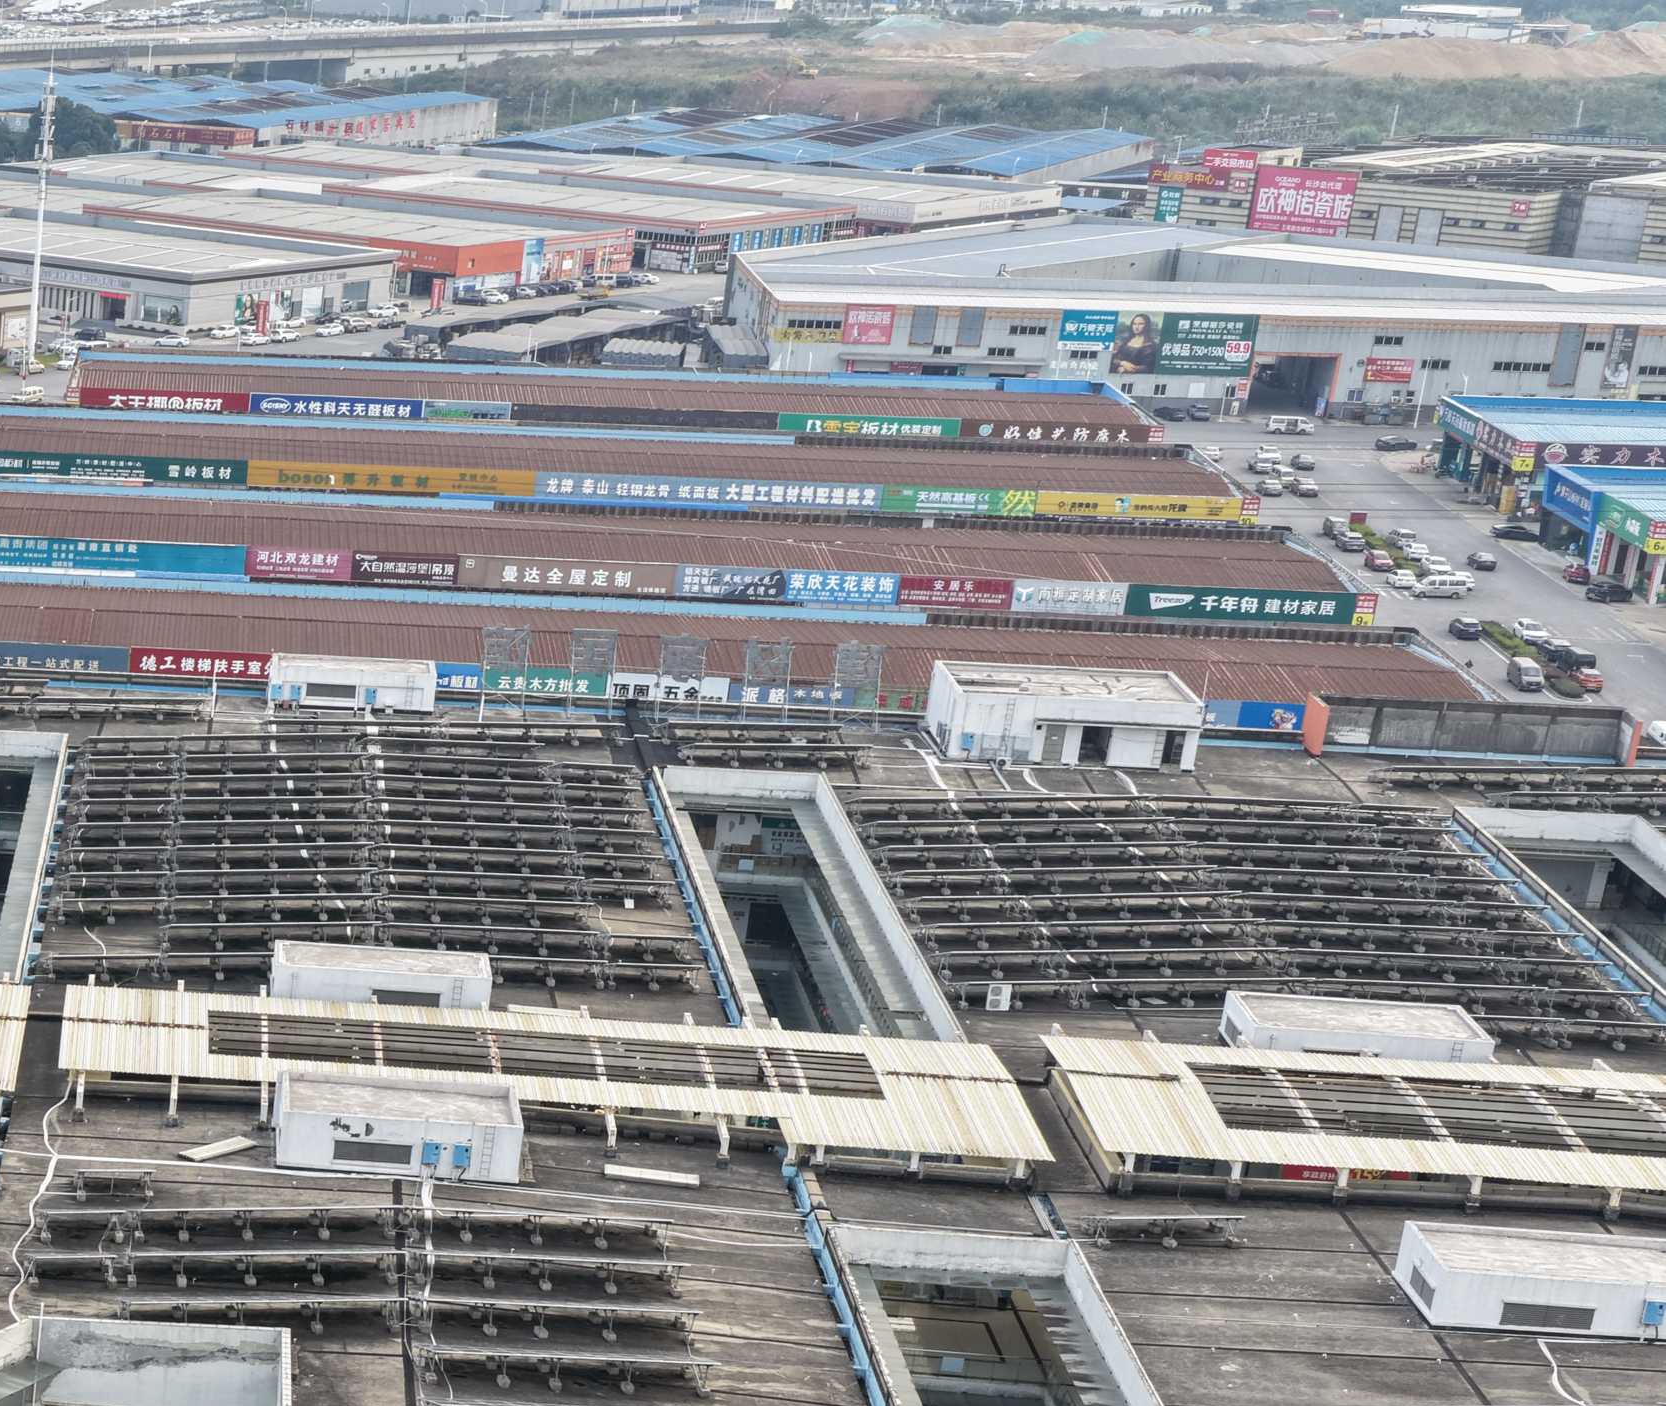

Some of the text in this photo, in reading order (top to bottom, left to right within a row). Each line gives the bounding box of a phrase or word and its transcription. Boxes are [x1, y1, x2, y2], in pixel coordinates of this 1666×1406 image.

[1257, 188, 1353, 219] 欧神诺瓷砖
[1226, 342, 1251, 352] 59.9
[293, 401, 411, 418] 水性科天无醛板材
[547, 478, 574, 493] 龙牌
[581, 479, 609, 494] 泰山
[616, 483, 671, 498] 轻钢龙骨
[678, 485, 719, 500] 纸面板
[257, 551, 340, 566] 河北双龙建材
[502, 566, 632, 588] 曼达全屋定制
[789, 574, 896, 593] 荣欣天花装饰
[1200, 595, 1259, 614] 千年舟
[1264, 598, 1337, 616] 建材家居
[140, 655, 176, 672] 德工
